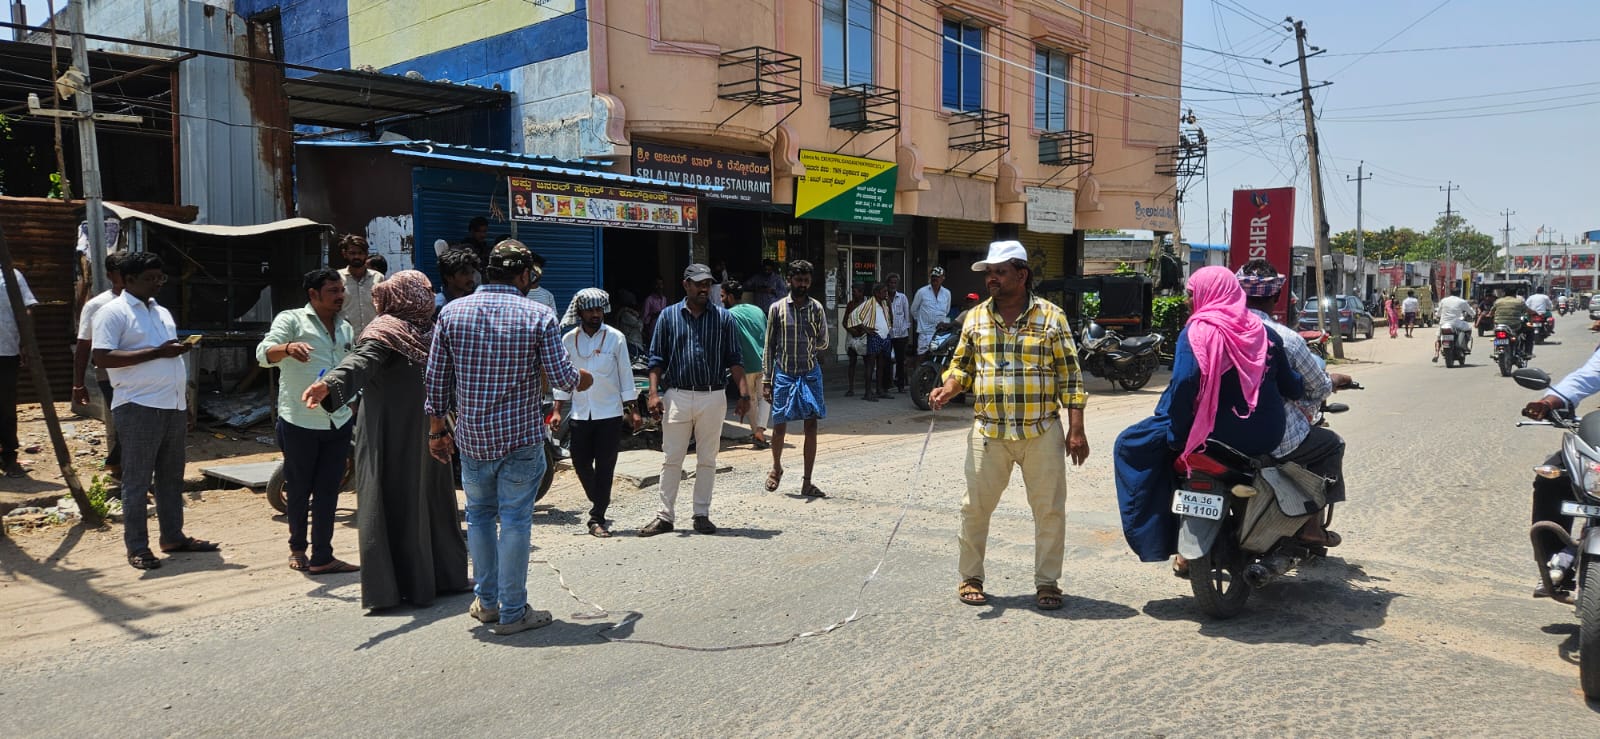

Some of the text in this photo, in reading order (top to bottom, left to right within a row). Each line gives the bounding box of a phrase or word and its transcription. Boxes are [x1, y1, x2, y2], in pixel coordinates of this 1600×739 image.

[654, 152, 687, 164] ಅಜಯ್
[717, 159, 724, 169] &
[636, 168, 653, 180] SRI
[683, 173, 702, 186] BAR
[705, 175, 712, 186] &
[714, 176, 771, 194] RESTAURANT
[1184, 494, 1212, 505] KA 36
[1176, 504, 1218, 517] EH 1100
